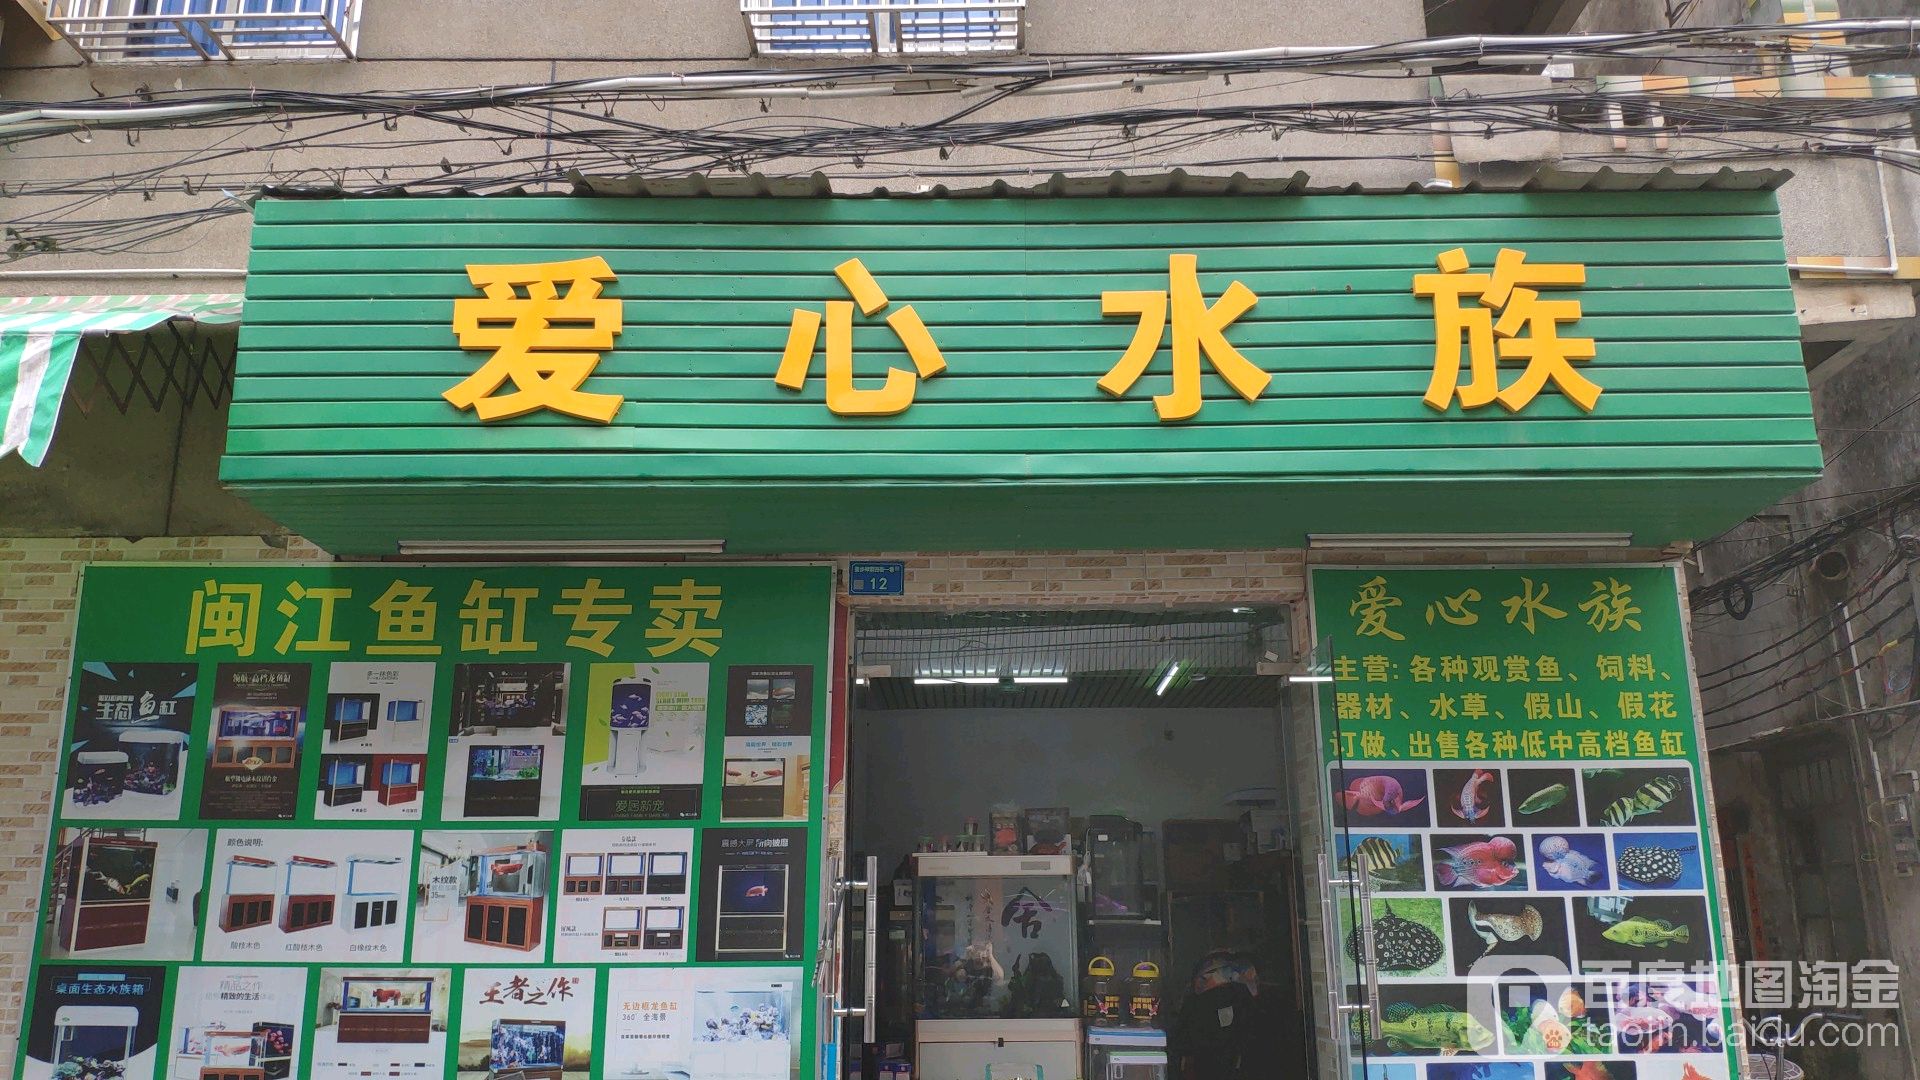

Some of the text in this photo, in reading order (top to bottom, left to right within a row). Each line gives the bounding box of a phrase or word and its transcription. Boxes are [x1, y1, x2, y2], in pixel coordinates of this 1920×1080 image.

[441, 247, 1605, 427] 爱心水族
[870, 577, 888, 590] 12
[184, 578, 724, 658] 闽江鱼缸专卖
[1349, 576, 1642, 641] 爱心水族
[1336, 691, 1678, 721] 器材、水草、假山、假花
[1330, 730, 1687, 759] 订做、出售各种低中高档鱼缸
[55, 982, 145, 996] 桌面生态水族箱
[479, 974, 574, 1005] 王者之作
[623, 1001, 677, 1011] 无边框龙鱼缸
